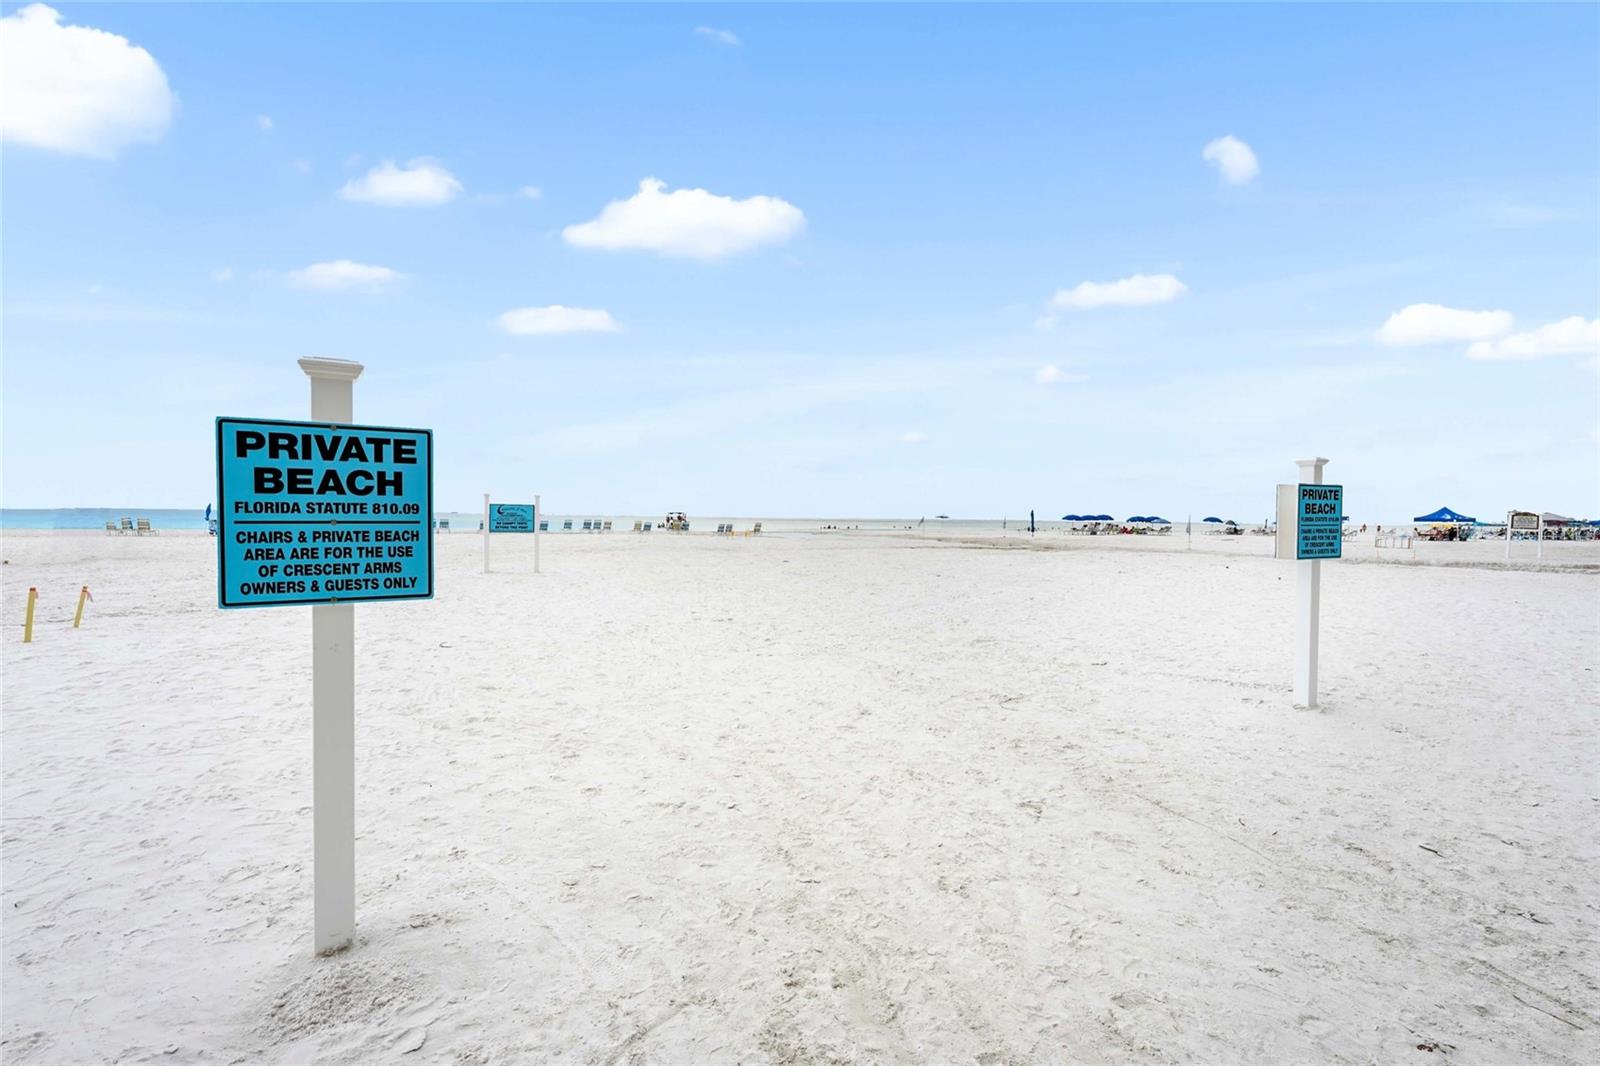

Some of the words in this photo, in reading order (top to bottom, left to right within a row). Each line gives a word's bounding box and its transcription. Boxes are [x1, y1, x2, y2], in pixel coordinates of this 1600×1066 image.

[236, 430, 417, 464] PRIVATE
[254, 467, 403, 496] BEACH
[1302, 489, 1339, 500] PRIVATE
[234, 501, 301, 514] FLORIDA
[306, 502, 368, 514] STATUTE
[372, 503, 420, 514] 810.09
[1305, 503, 1336, 514] BEACH
[236, 531, 293, 544] CHAIRS
[298, 531, 307, 543] &
[312, 530, 370, 543] PRIVATE
[375, 530, 419, 542] BEACH
[244, 548, 285, 560] AREA
[290, 548, 319, 559] ARE
[324, 547, 352, 559] FOR
[357, 546, 383, 558] THE
[388, 546, 413, 557] USE
[258, 565, 278, 578] OF
[284, 563, 360, 576] CRESCENT
[364, 562, 402, 574] ARMS
[240, 581, 305, 595] OWNERS
[310, 580, 320, 592] &
[327, 579, 379, 591] GUESTS
[384, 577, 417, 589] ONLY
